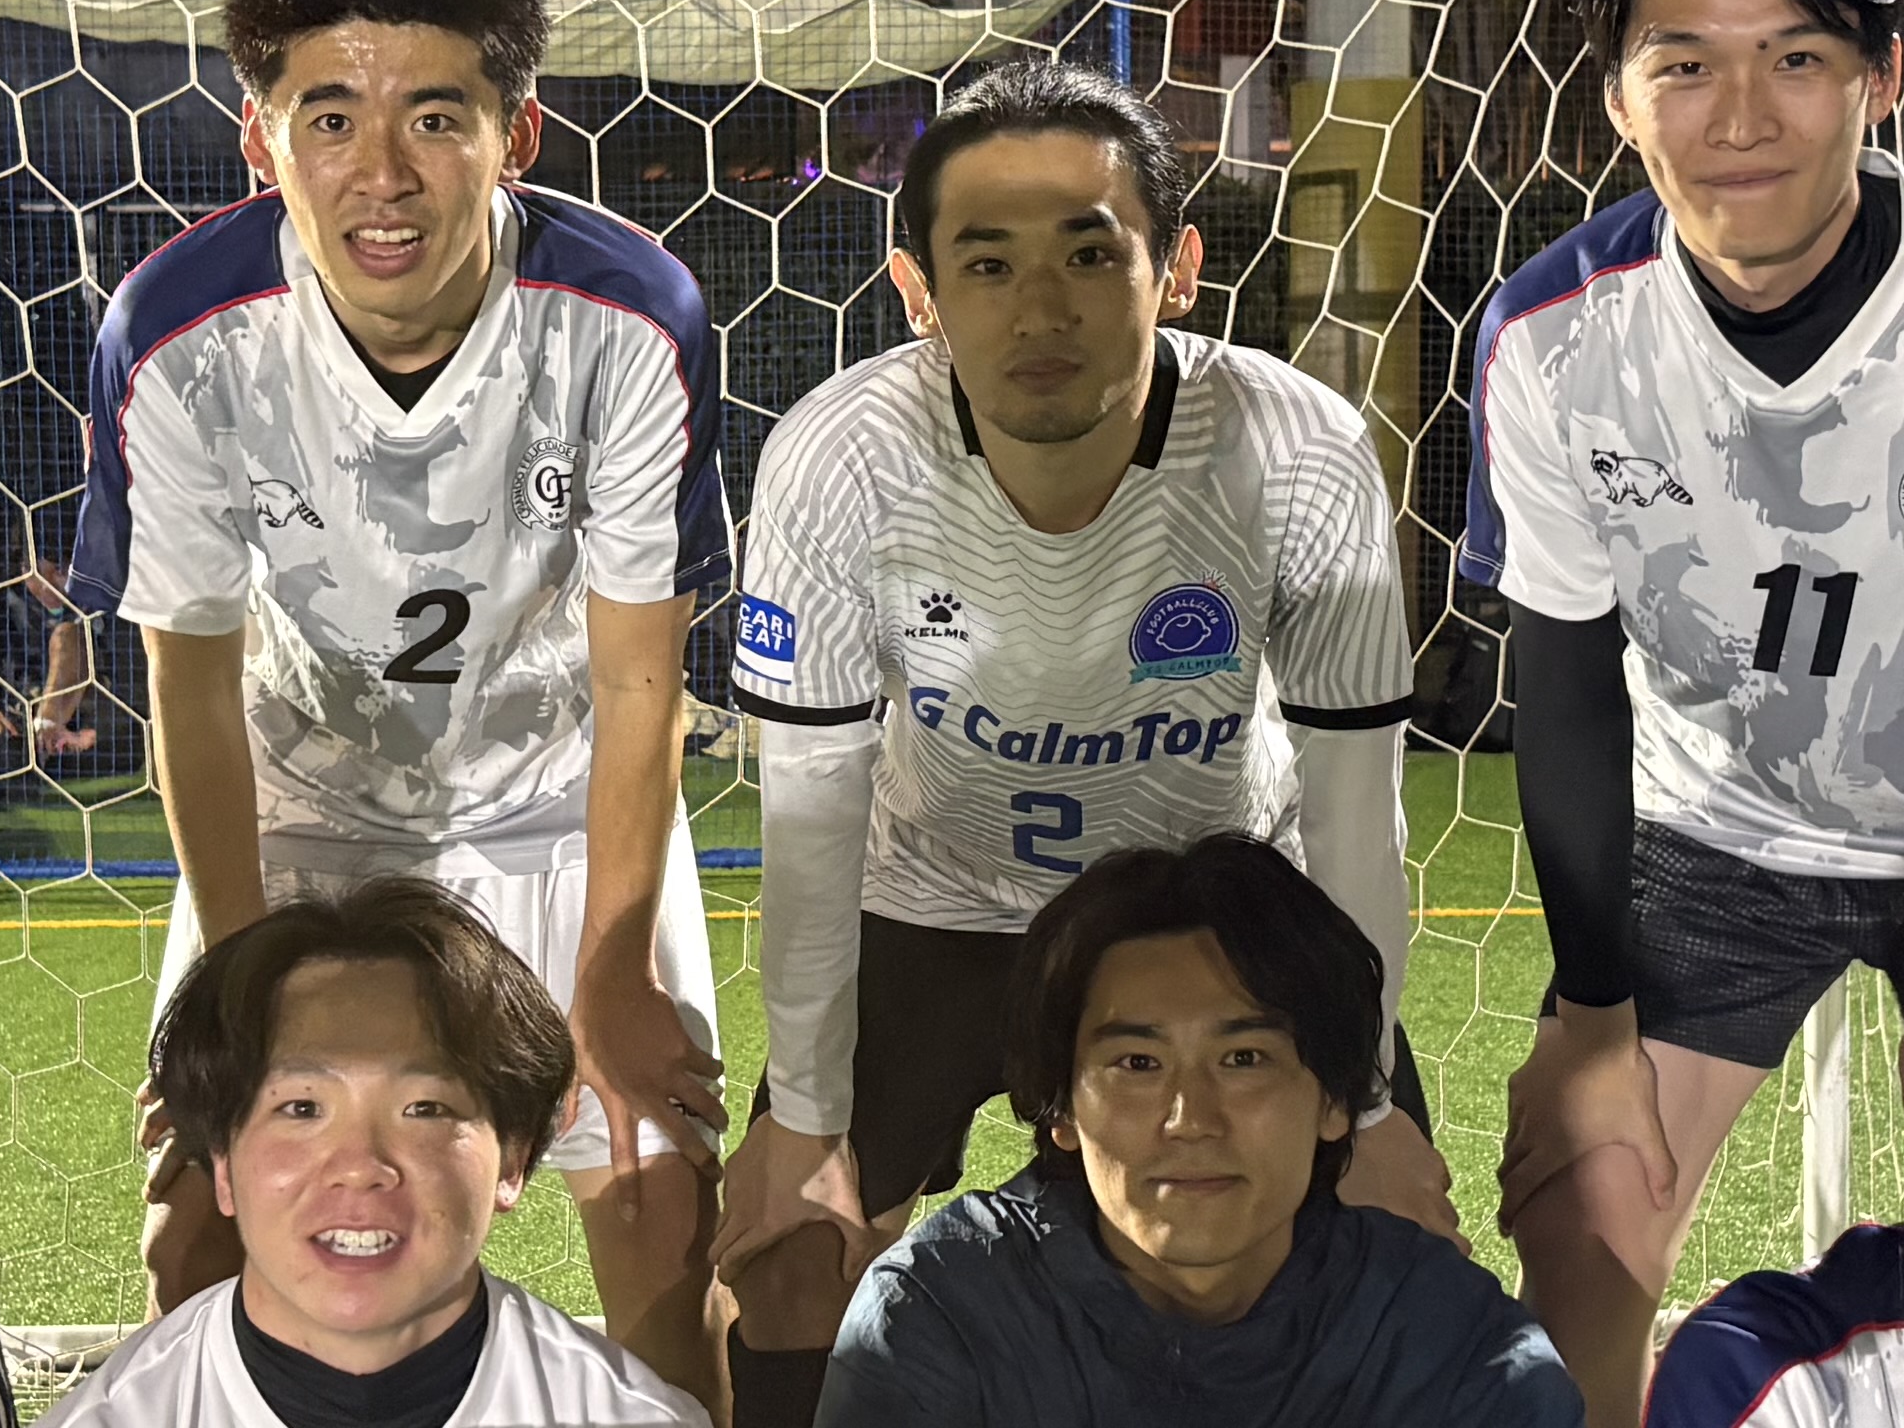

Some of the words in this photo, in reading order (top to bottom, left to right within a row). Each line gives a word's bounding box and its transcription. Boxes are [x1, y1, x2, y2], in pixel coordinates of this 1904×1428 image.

[382, 588, 471, 684] 2
[738, 621, 786, 652] EAT
[739, 602, 793, 639] CARI
[904, 627, 969, 643] KELME
[1752, 563, 1859, 677] 11
[909, 686, 950, 730] G
[964, 705, 1242, 766] CalmTop
[1010, 791, 1083, 874] 2
